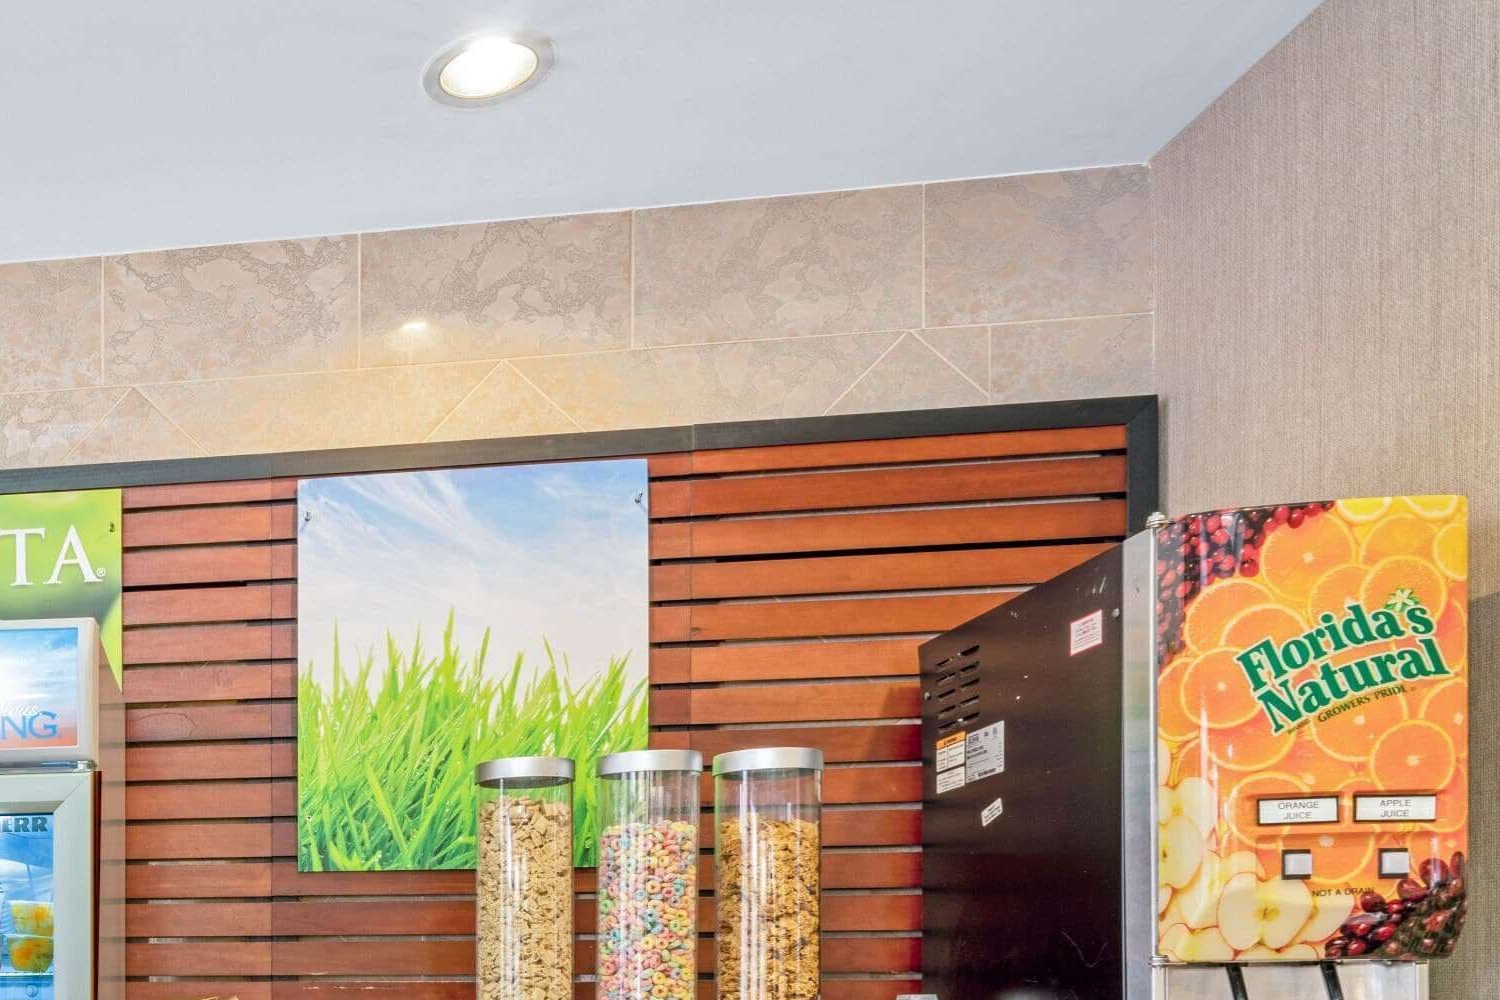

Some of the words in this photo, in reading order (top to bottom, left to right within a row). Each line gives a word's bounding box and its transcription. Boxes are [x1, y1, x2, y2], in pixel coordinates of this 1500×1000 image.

[1236, 603, 1434, 692] Florida's
[1257, 638, 1452, 733] Natural
[1317, 695, 1371, 723] GROWERS
[1374, 684, 1409, 701] PRIDE
[1277, 800, 1320, 809] ORANGE
[1379, 799, 1412, 807] APPLE
[1283, 811, 1312, 820] JUICE
[1380, 809, 1410, 818] JUICE
[1311, 888, 1333, 897] NOT
